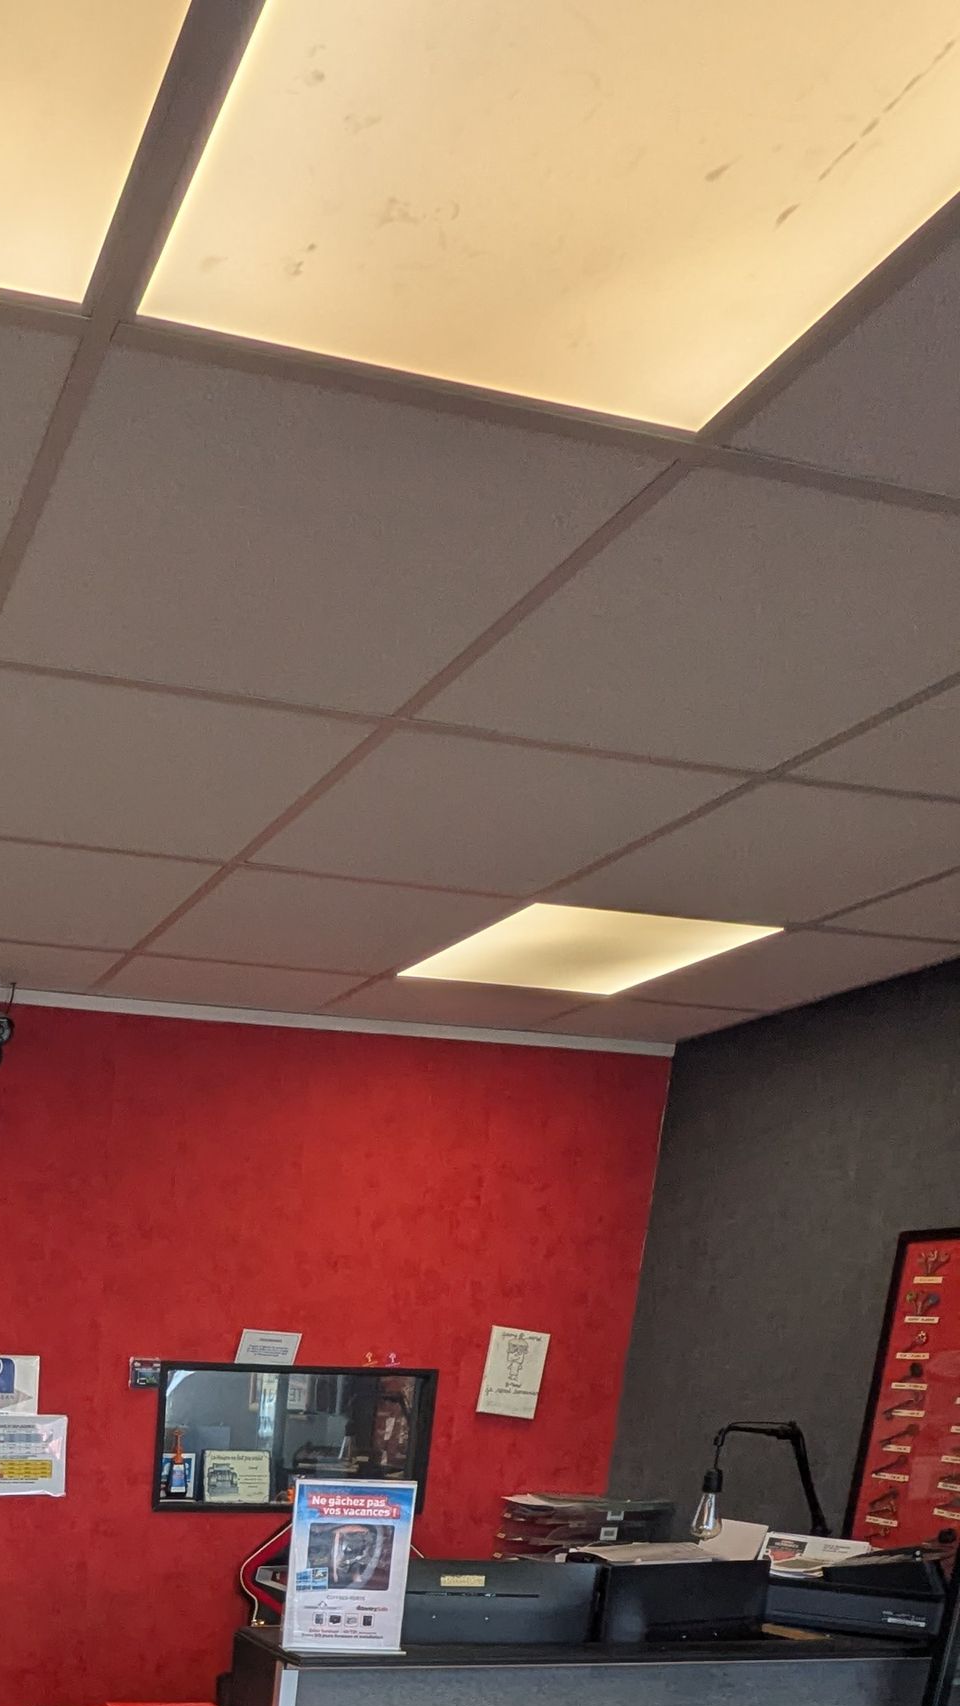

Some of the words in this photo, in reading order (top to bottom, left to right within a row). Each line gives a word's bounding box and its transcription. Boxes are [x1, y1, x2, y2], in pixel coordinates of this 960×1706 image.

[311, 1495, 326, 1505] Ne
[328, 1496, 365, 1508] gâchez
[366, 1499, 386, 1508] pas
[323, 1507, 341, 1516] vos
[343, 1508, 391, 1518] vacances
